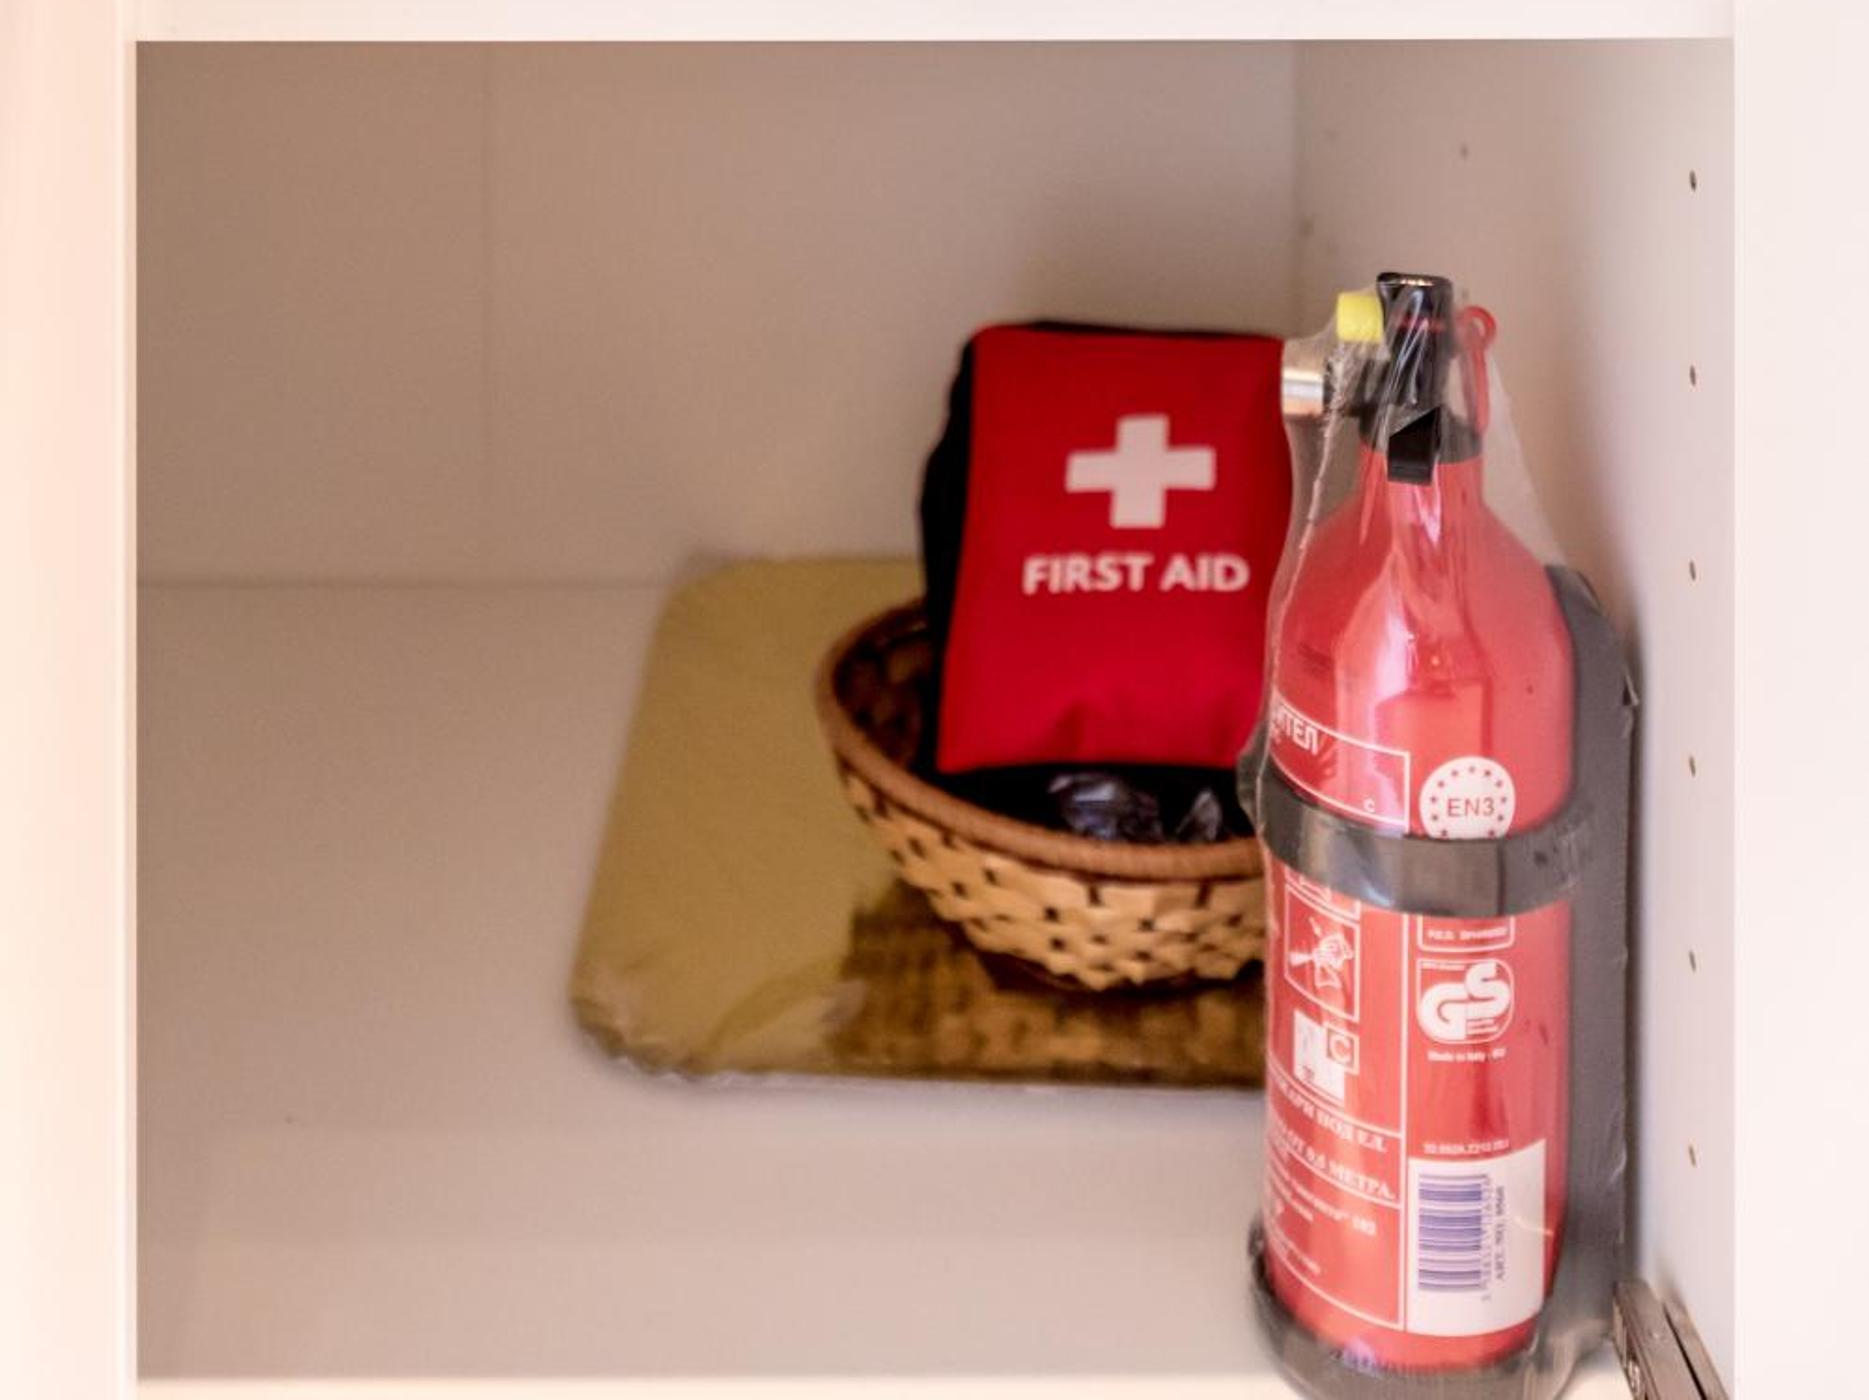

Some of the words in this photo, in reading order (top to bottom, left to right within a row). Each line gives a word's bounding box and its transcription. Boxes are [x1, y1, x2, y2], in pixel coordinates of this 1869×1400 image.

[1022, 552, 1154, 596] FIRST
[1160, 552, 1251, 593] AID
[1447, 797, 1496, 818] EN3
